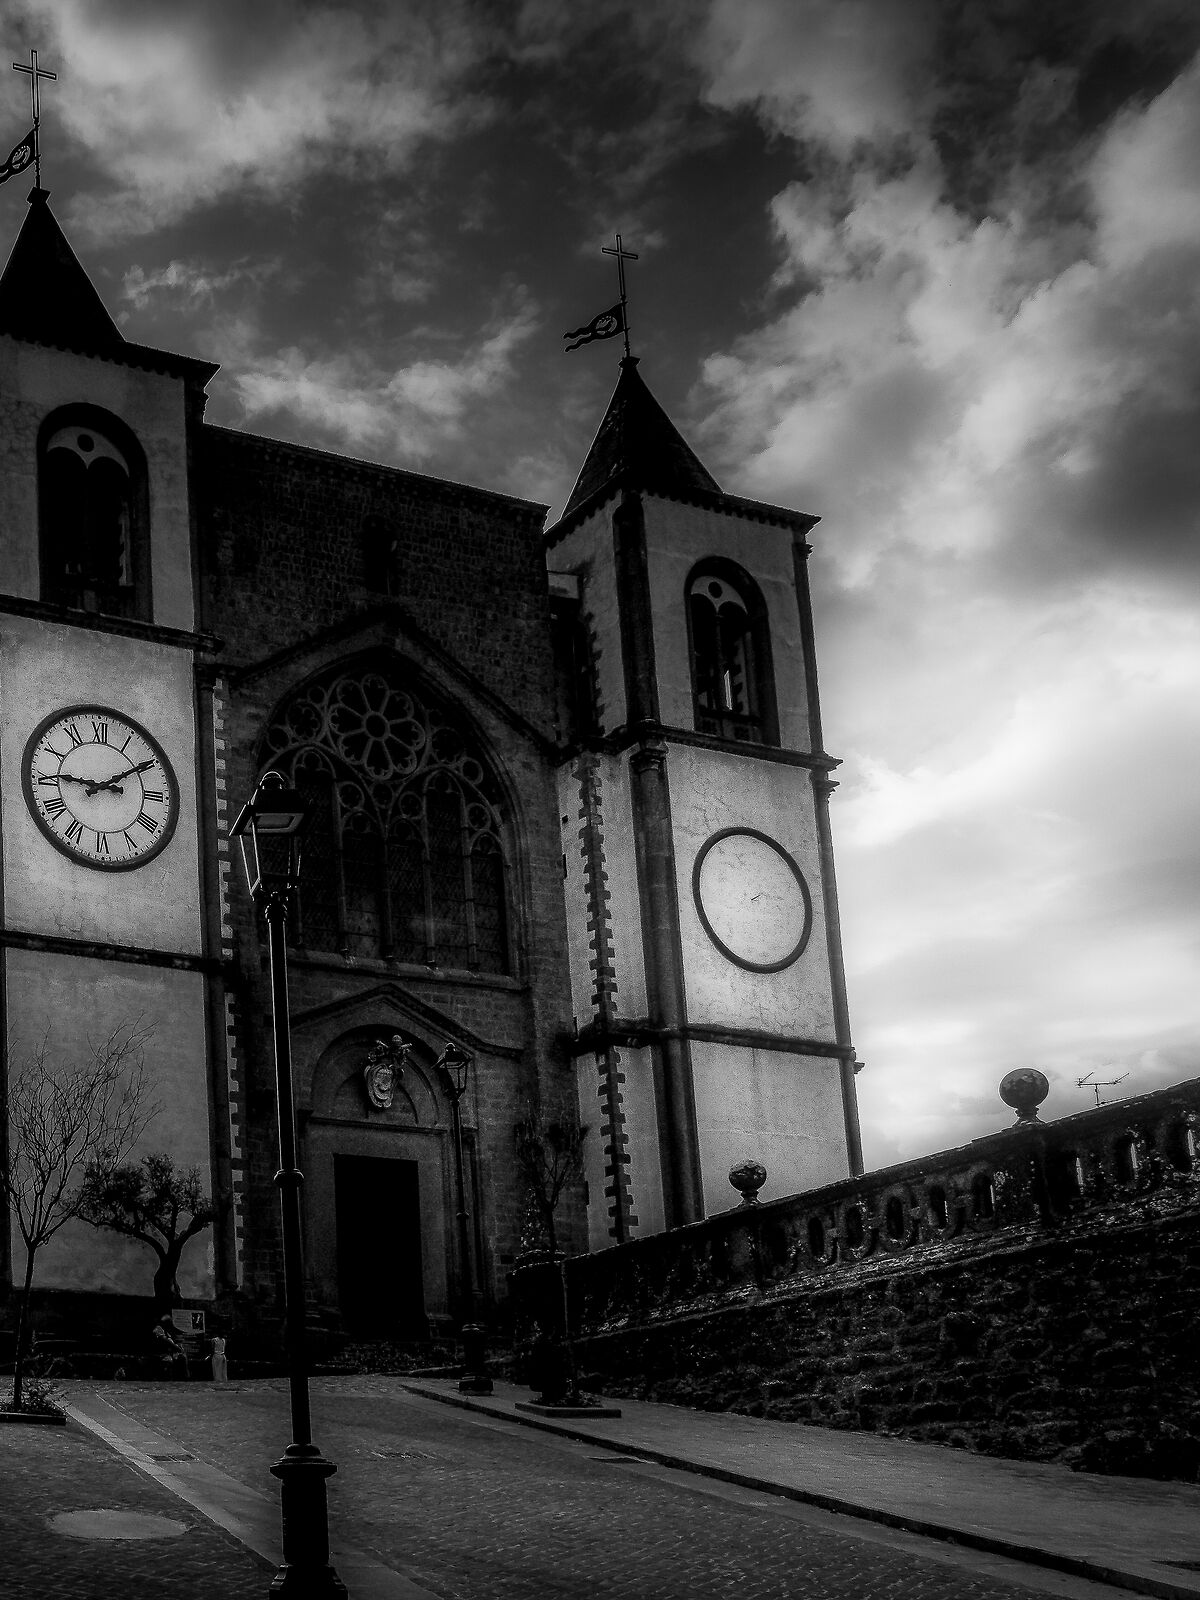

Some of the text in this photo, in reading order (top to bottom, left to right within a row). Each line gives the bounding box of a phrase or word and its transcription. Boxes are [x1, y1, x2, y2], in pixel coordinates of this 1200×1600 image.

[63, 723, 83, 747] XI
[92, 721, 108, 743] XII
[43, 742, 66, 763] X
[120, 735, 132, 753] I
[37, 771, 58, 787] IX
[143, 790, 164, 803] III
[43, 797, 67, 821] VIII
[64, 819, 84, 844] VII
[136, 811, 159, 834] IIII
[96, 831, 109, 854] VI
[123, 829, 138, 851] V
